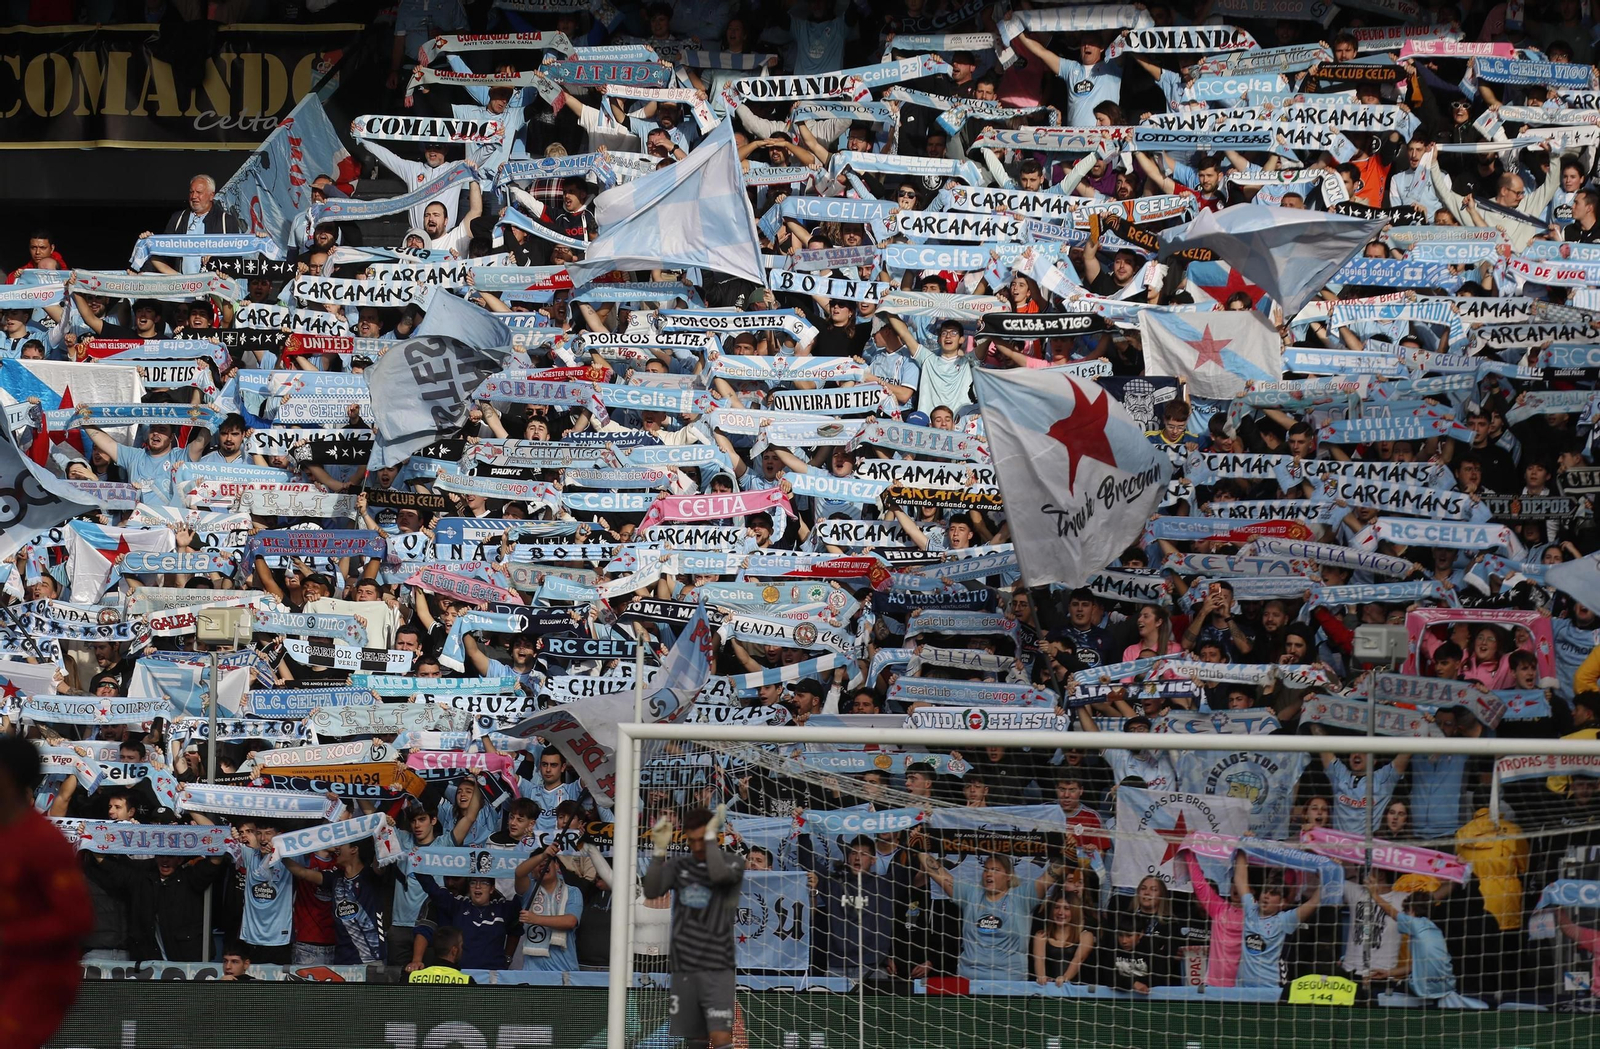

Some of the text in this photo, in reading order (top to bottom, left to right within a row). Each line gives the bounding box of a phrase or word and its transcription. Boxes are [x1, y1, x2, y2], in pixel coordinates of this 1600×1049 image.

[1272, 0, 1304, 13] XOGO
[1387, 25, 1431, 39] DE VIGO
[1412, 41, 1495, 55] RC CELTA
[863, 67, 900, 82] Celta
[1333, 67, 1397, 81] CLUB CELTA
[1477, 58, 1588, 80] R.C. CELTA VIGO
[193, 108, 280, 132] Celta
[995, 131, 1087, 149] CELTA
[1134, 132, 1197, 145] LONDON
[1211, 132, 1272, 145] CELTAS
[796, 199, 884, 219] RC CELTA
[900, 215, 1020, 238] CARCAMÄNS
[155, 237, 249, 253] realclubceltadevigo
[1130, 230, 1156, 249] REAL
[1535, 270, 1552, 282] DE
[105, 279, 204, 292] realclubceltadevigo
[296, 279, 414, 303] CARCAMÄNS
[671, 316, 786, 330] PORCOS CELTAS
[1002, 316, 1092, 331] CELTA VIGO
[302, 336, 351, 351] UNITED
[589, 332, 711, 348] PORCOS CELTAS
[617, 346, 637, 358] Vigo
[1434, 352, 1472, 367] CELTA
[152, 365, 196, 382] DE TEIS
[530, 369, 585, 379] MANCHESTER UNITED
[498, 382, 569, 400] CELTA
[774, 390, 881, 411] OLIVEIRA DE TEIS
[130, 405, 178, 416] CELTA
[718, 413, 756, 428] FORA
[886, 429, 954, 452] CELTA
[530, 448, 603, 461] CELTA VIGO
[190, 461, 219, 472] NOSA
[391, 493, 446, 508] CLUB CELTA
[680, 495, 749, 518] CELTA
[935, 501, 968, 512] soñando
[1341, 482, 1462, 516] CARCAMÄNS
[1521, 498, 1569, 515] DEPOR
[648, 527, 741, 546] CARCAMÄNS
[1233, 525, 1287, 534] MANCHESTER UNITED
[1390, 524, 1489, 544] RC CELTA
[684, 556, 725, 569] Celta
[815, 560, 872, 571] MANCHESTER UNITED
[884, 552, 926, 564] FEITO
[1183, 554, 1291, 576] CELTA
[1256, 540, 1407, 575] RC CELTA VIGO
[421, 570, 501, 602] Eu Son do Celta
[946, 589, 989, 604] XEITO
[270, 616, 306, 632] BAIXO
[354, 645, 406, 664] CELESTE
[548, 639, 655, 658] RC CELTA
[919, 647, 985, 667] CELTA
[906, 685, 1017, 705] realclubceltadevigo
[1379, 677, 1455, 701] CELTA
[64, 702, 95, 717] VIGO
[255, 691, 373, 711] R.C. CELTA VIGO
[311, 710, 437, 728] CELTA
[986, 711, 1069, 733] CELESTE
[1166, 717, 1283, 737] CELTA
[52, 755, 73, 766] Vigo
[262, 742, 365, 767] FORA DE XOGO
[422, 753, 489, 770] CELTA
[1498, 757, 1543, 773] TROPAS
[205, 793, 300, 811] R.C. CELTA
[1137, 800, 1169, 833] TROPAS
[1169, 793, 1183, 804] DE
[117, 829, 199, 848] CELTA
[282, 813, 382, 853] RC CELTA
[425, 851, 467, 868] IAGO
[1296, 979, 1354, 994] SEGURIDAD
[1309, 992, 1333, 1003] 144
